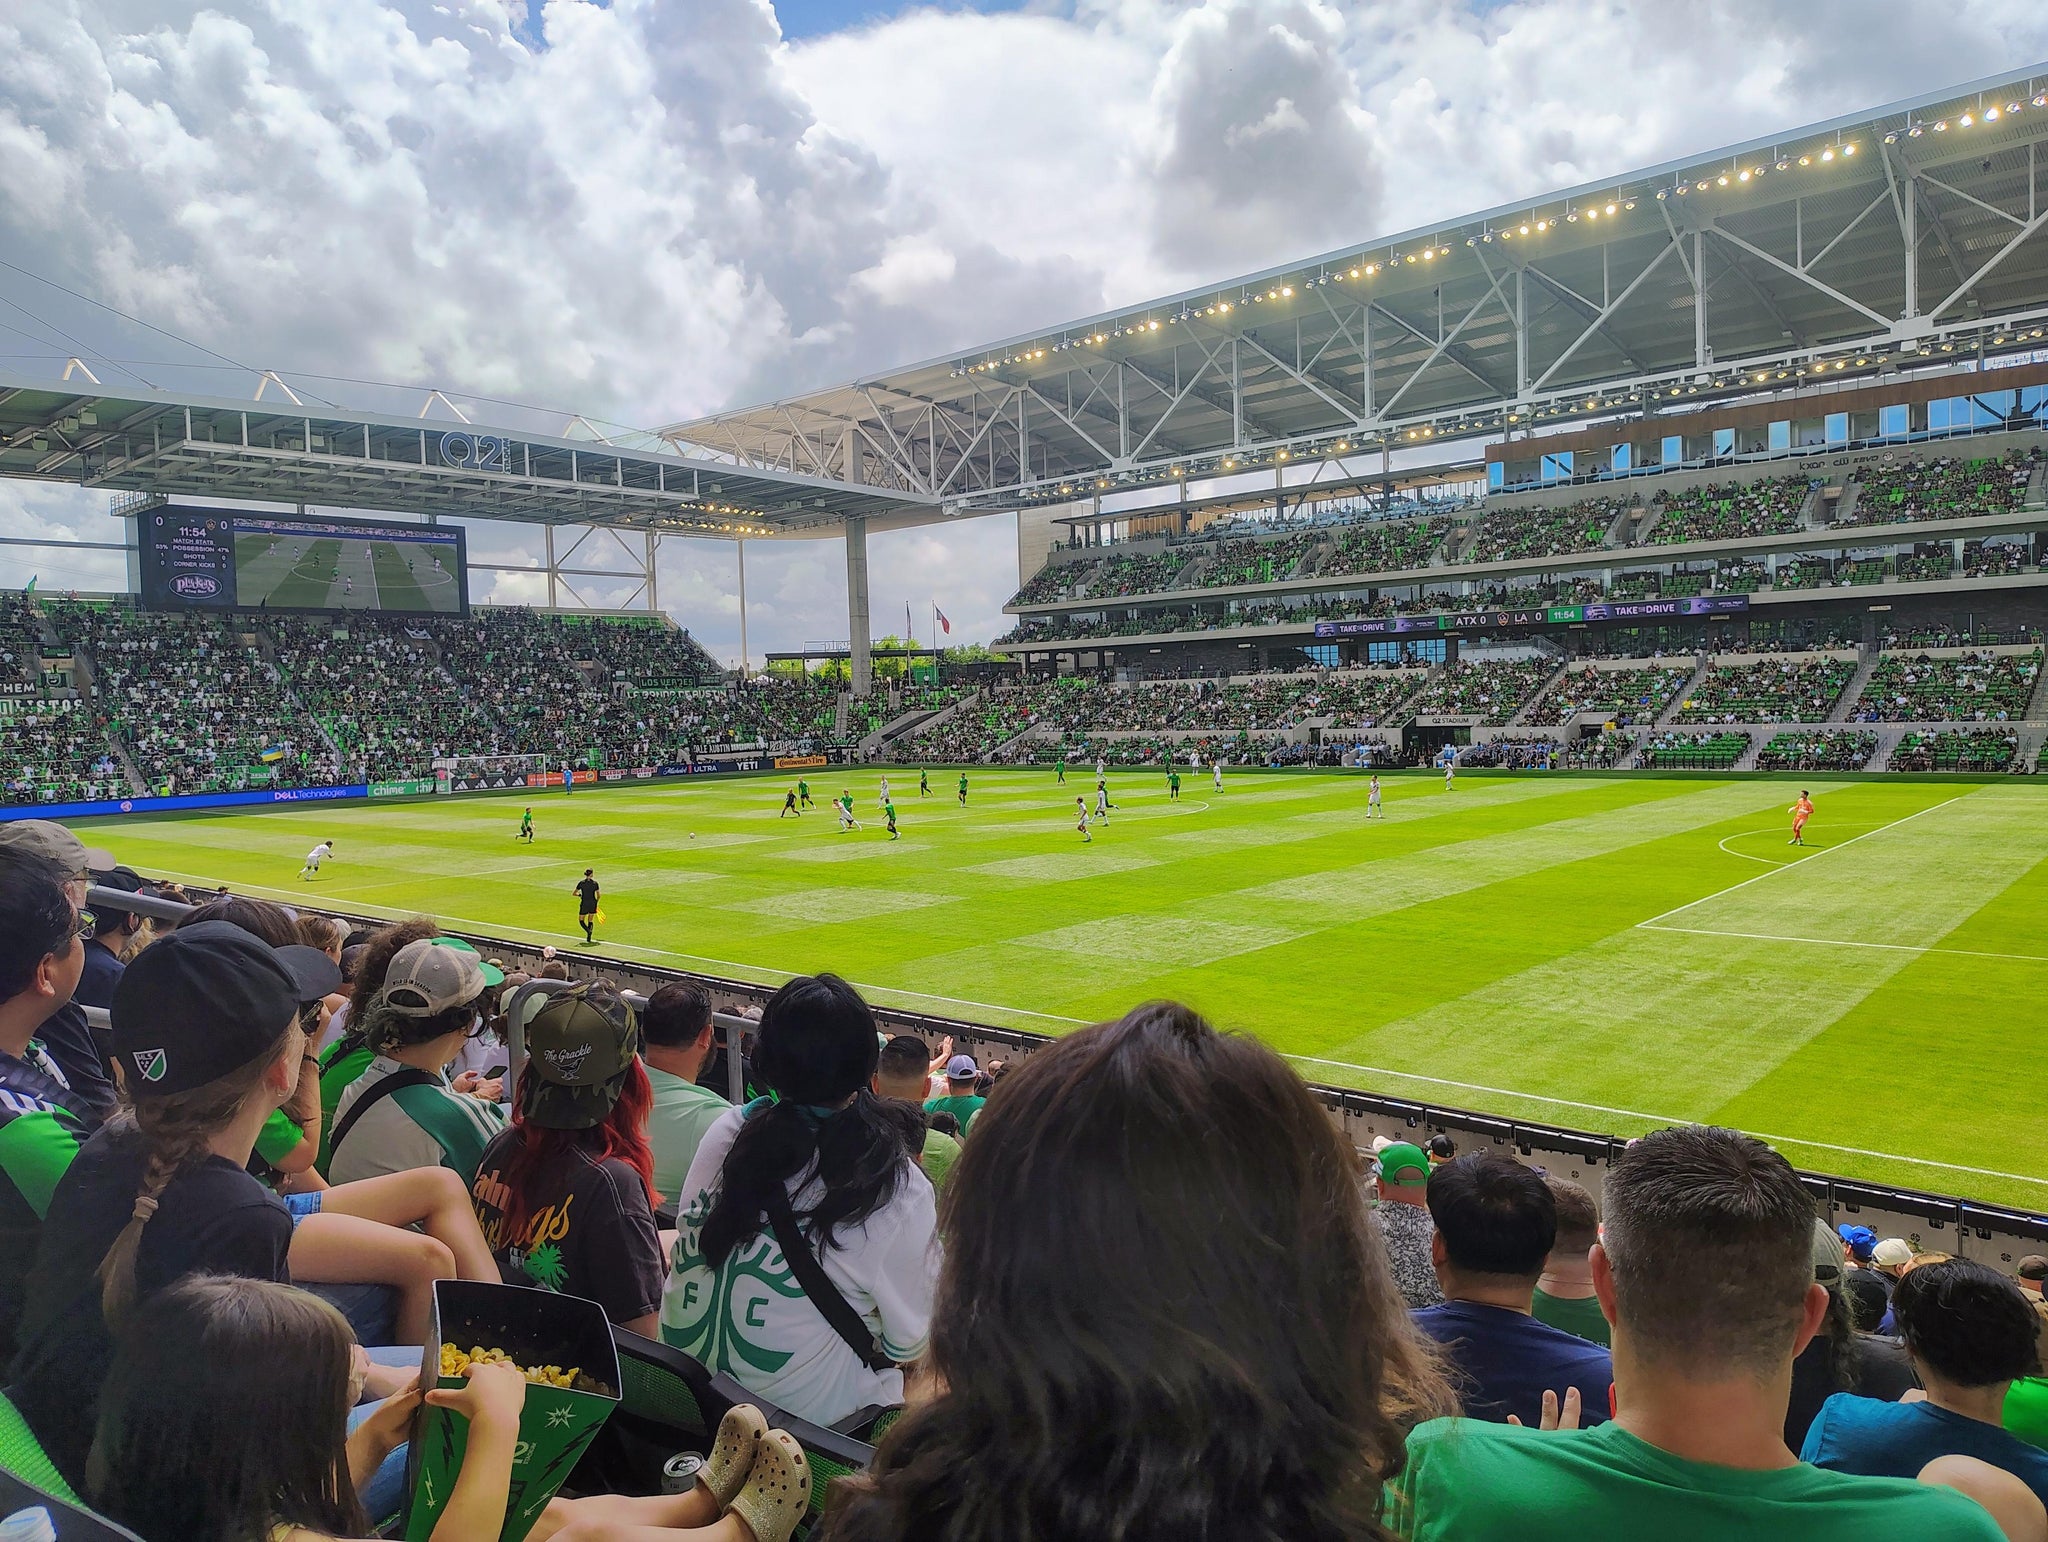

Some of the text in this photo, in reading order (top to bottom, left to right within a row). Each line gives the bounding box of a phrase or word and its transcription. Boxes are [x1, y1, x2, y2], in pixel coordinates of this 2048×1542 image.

[440, 431, 503, 474] Q2
[156, 516, 164, 526] 0
[220, 520, 228, 530] 0
[179, 526, 206, 537] 11:54
[1553, 610, 1575, 620] 11:54
[1615, 606, 1639, 616] TAKE
[1645, 603, 1675, 614] DRIVE
[1455, 615, 1487, 626] ATX 0
[1514, 612, 1542, 622] LA 0
[1339, 625, 1358, 633] TAKE
[1362, 622, 1385, 632] DRIVE
[0, 683, 36, 694] HEM
[641, 679, 659, 687] LOS
[709, 743, 731, 753] AUSTIN
[693, 764, 718, 773] ULTRA
[736, 761, 759, 771] YETI
[274, 788, 347, 800] DELL Technologies
[373, 785, 405, 796] chime
[544, 1042, 592, 1063] The Grackle
[682, 1281, 769, 1327] F C
